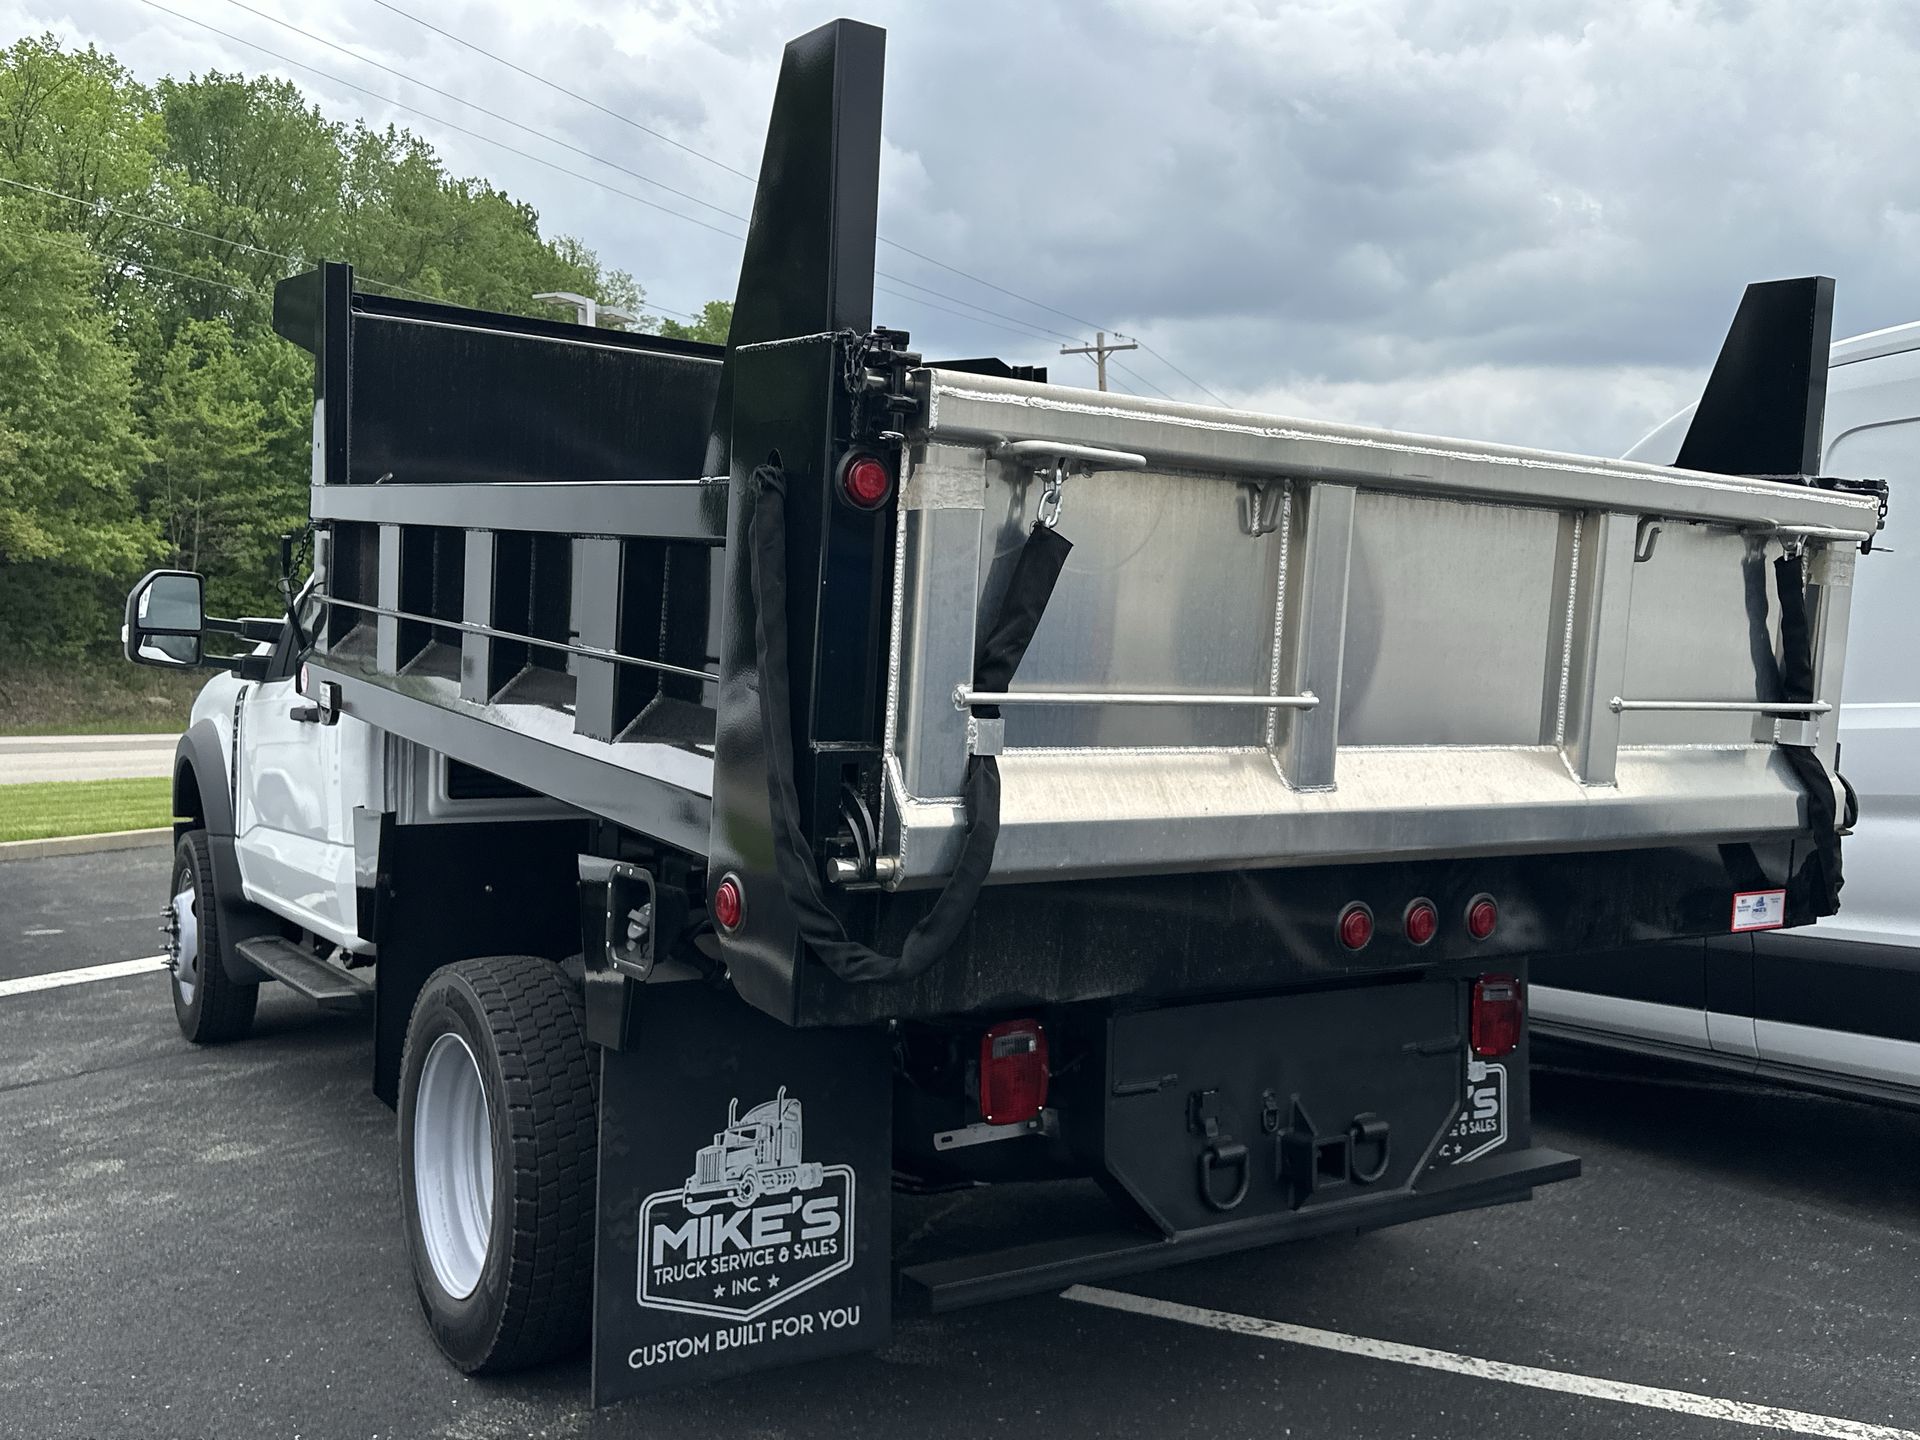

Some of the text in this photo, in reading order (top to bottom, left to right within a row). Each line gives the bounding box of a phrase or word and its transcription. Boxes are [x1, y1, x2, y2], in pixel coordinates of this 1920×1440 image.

[1459, 1085, 1498, 1121] 'S
[1469, 1119, 1497, 1134] SALES
[652, 1195, 841, 1266] MIKE'S
[654, 1238, 838, 1285] TRUCK SERVICE & SALES
[731, 1276, 761, 1296] INC.
[628, 1305, 860, 1369] CUSTOM BUILT FOR YOU
